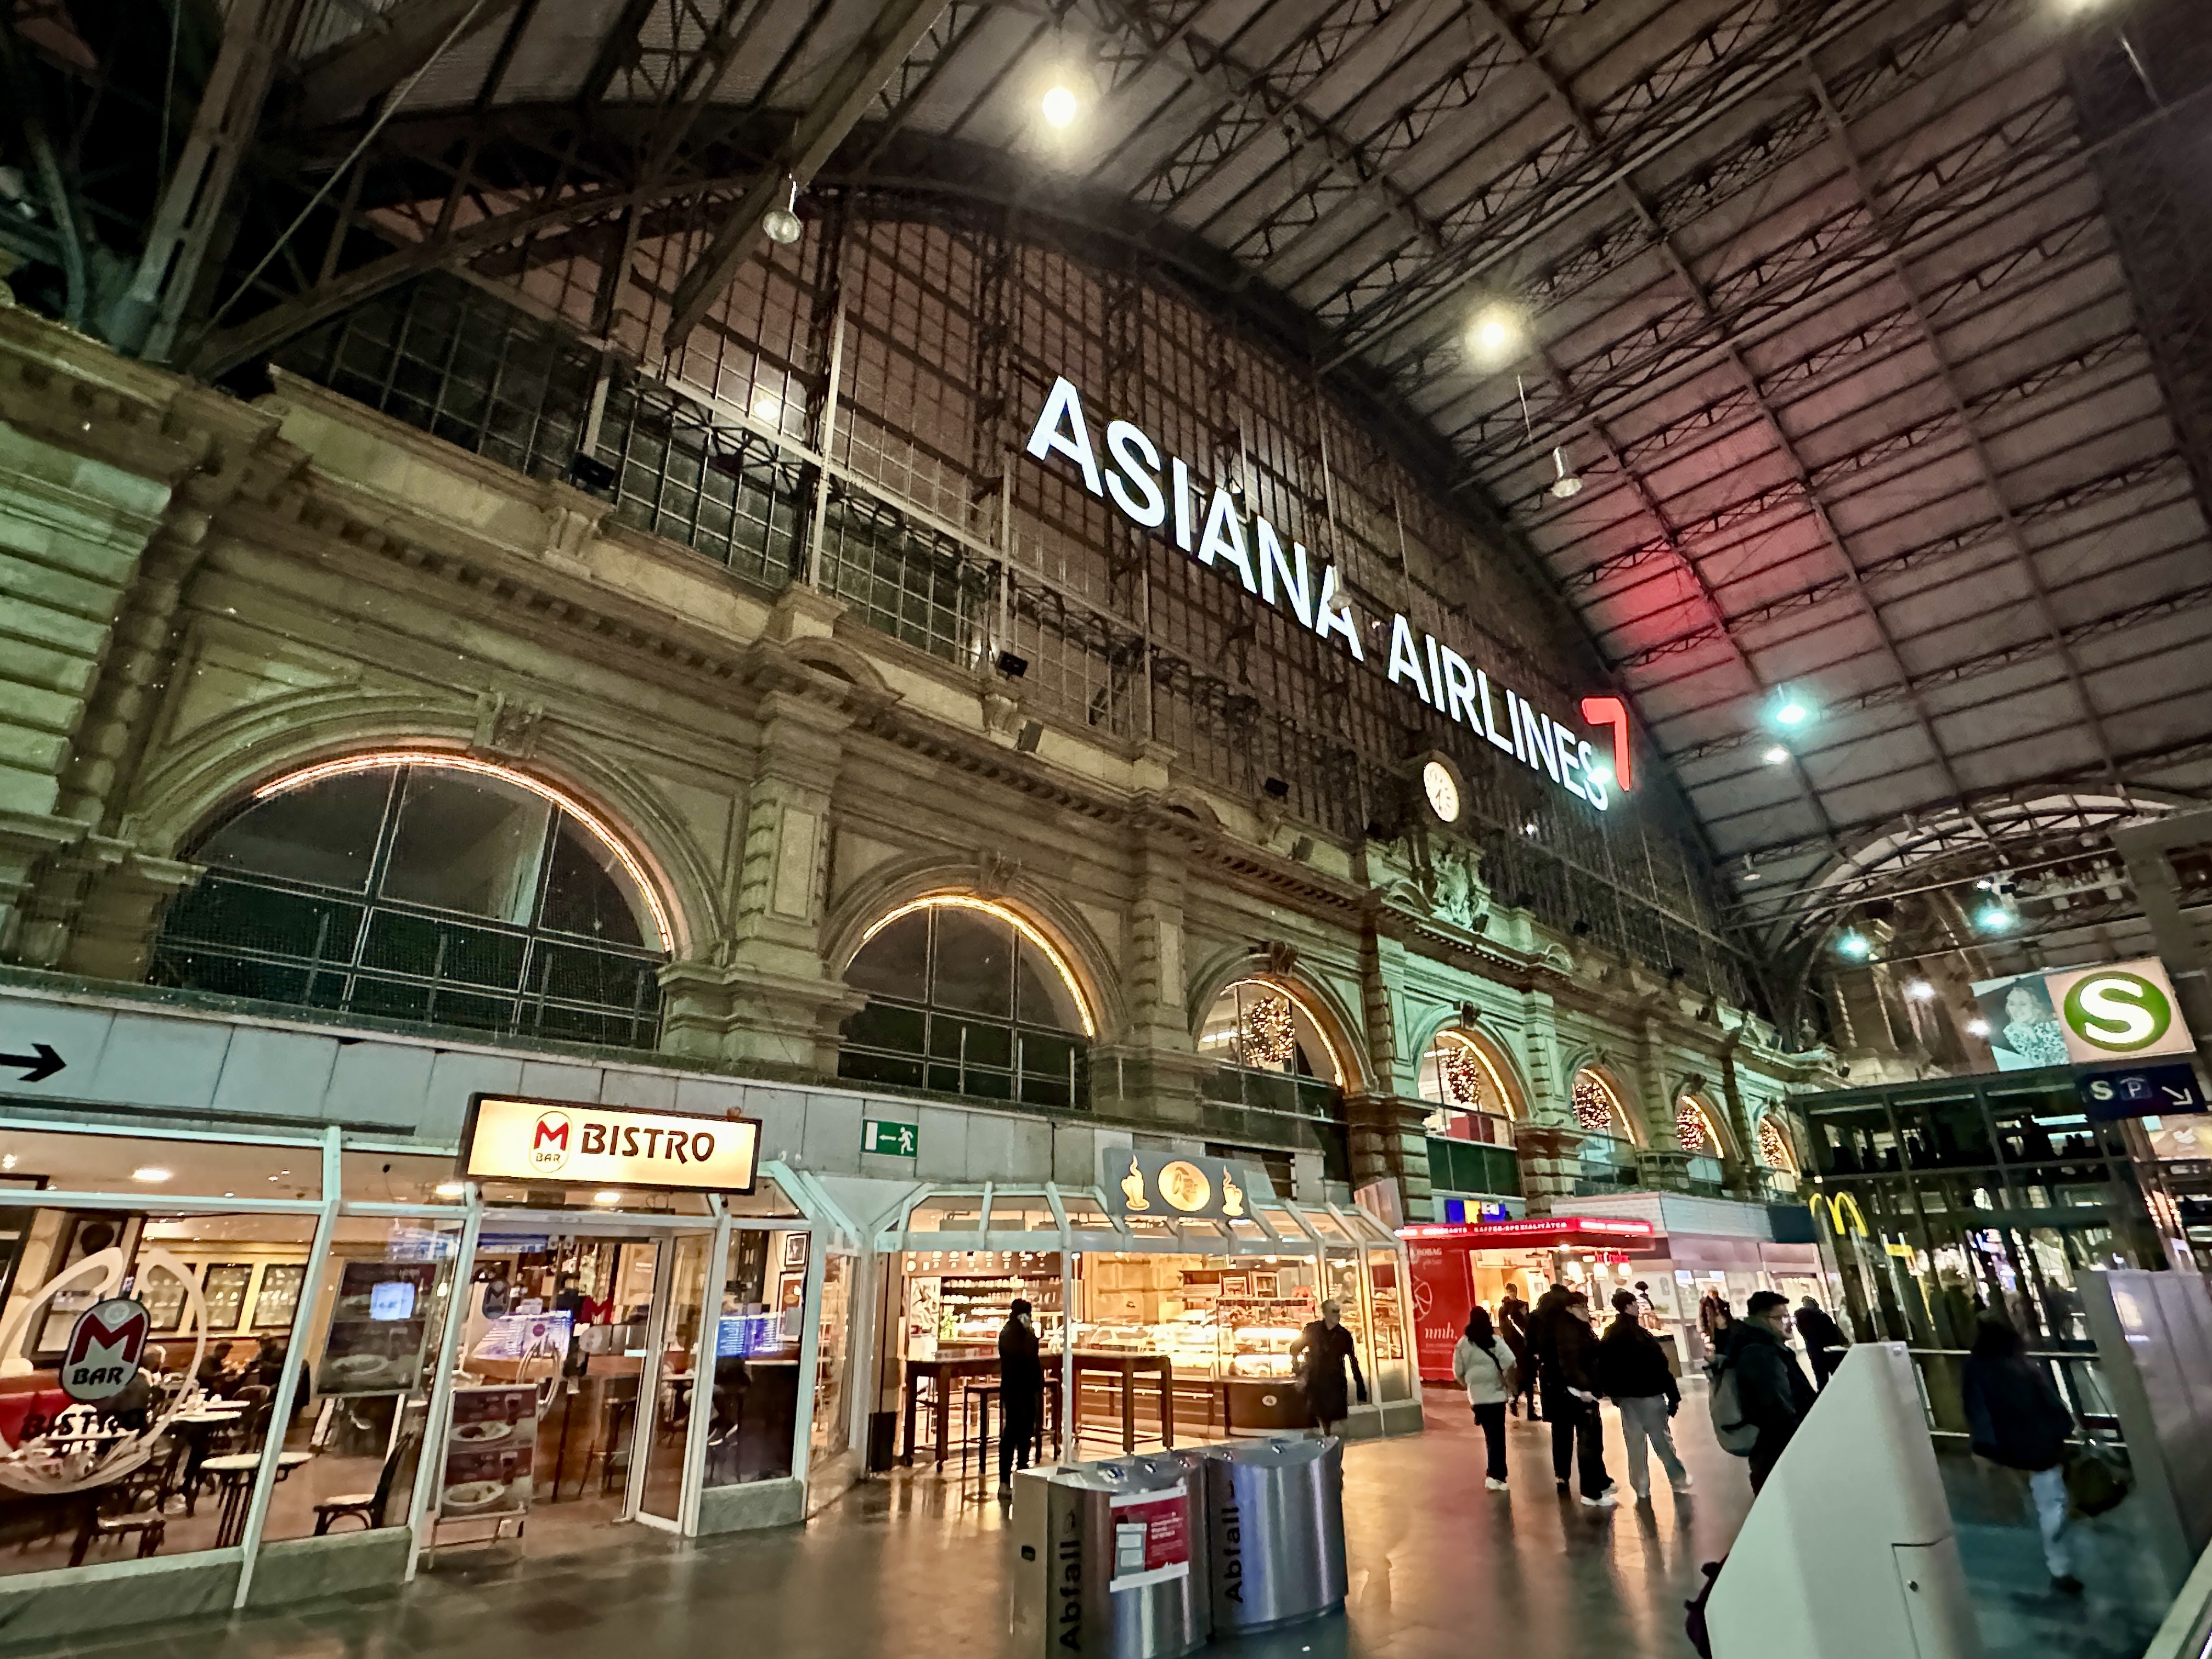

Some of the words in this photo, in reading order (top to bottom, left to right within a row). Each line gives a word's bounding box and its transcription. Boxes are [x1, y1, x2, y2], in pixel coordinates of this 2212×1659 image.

[1026, 375, 1364, 662] ASIANA
[1388, 613, 1608, 810] AIRLINES
[2080, 979, 2154, 1043] S
[2091, 1080, 2113, 1099] S
[2128, 1082, 2141, 1097] P
[533, 1120, 568, 1151] M
[582, 1124, 714, 1164] BISTRO
[536, 1153, 561, 1163] BAR
[70, 1312, 145, 1366] M
[72, 1367, 124, 1386] BAR
[19, 1408, 145, 1440] BISTRO
[1222, 1508, 1243, 1603] Abfall
[1059, 1541, 1081, 1652] Abfall
